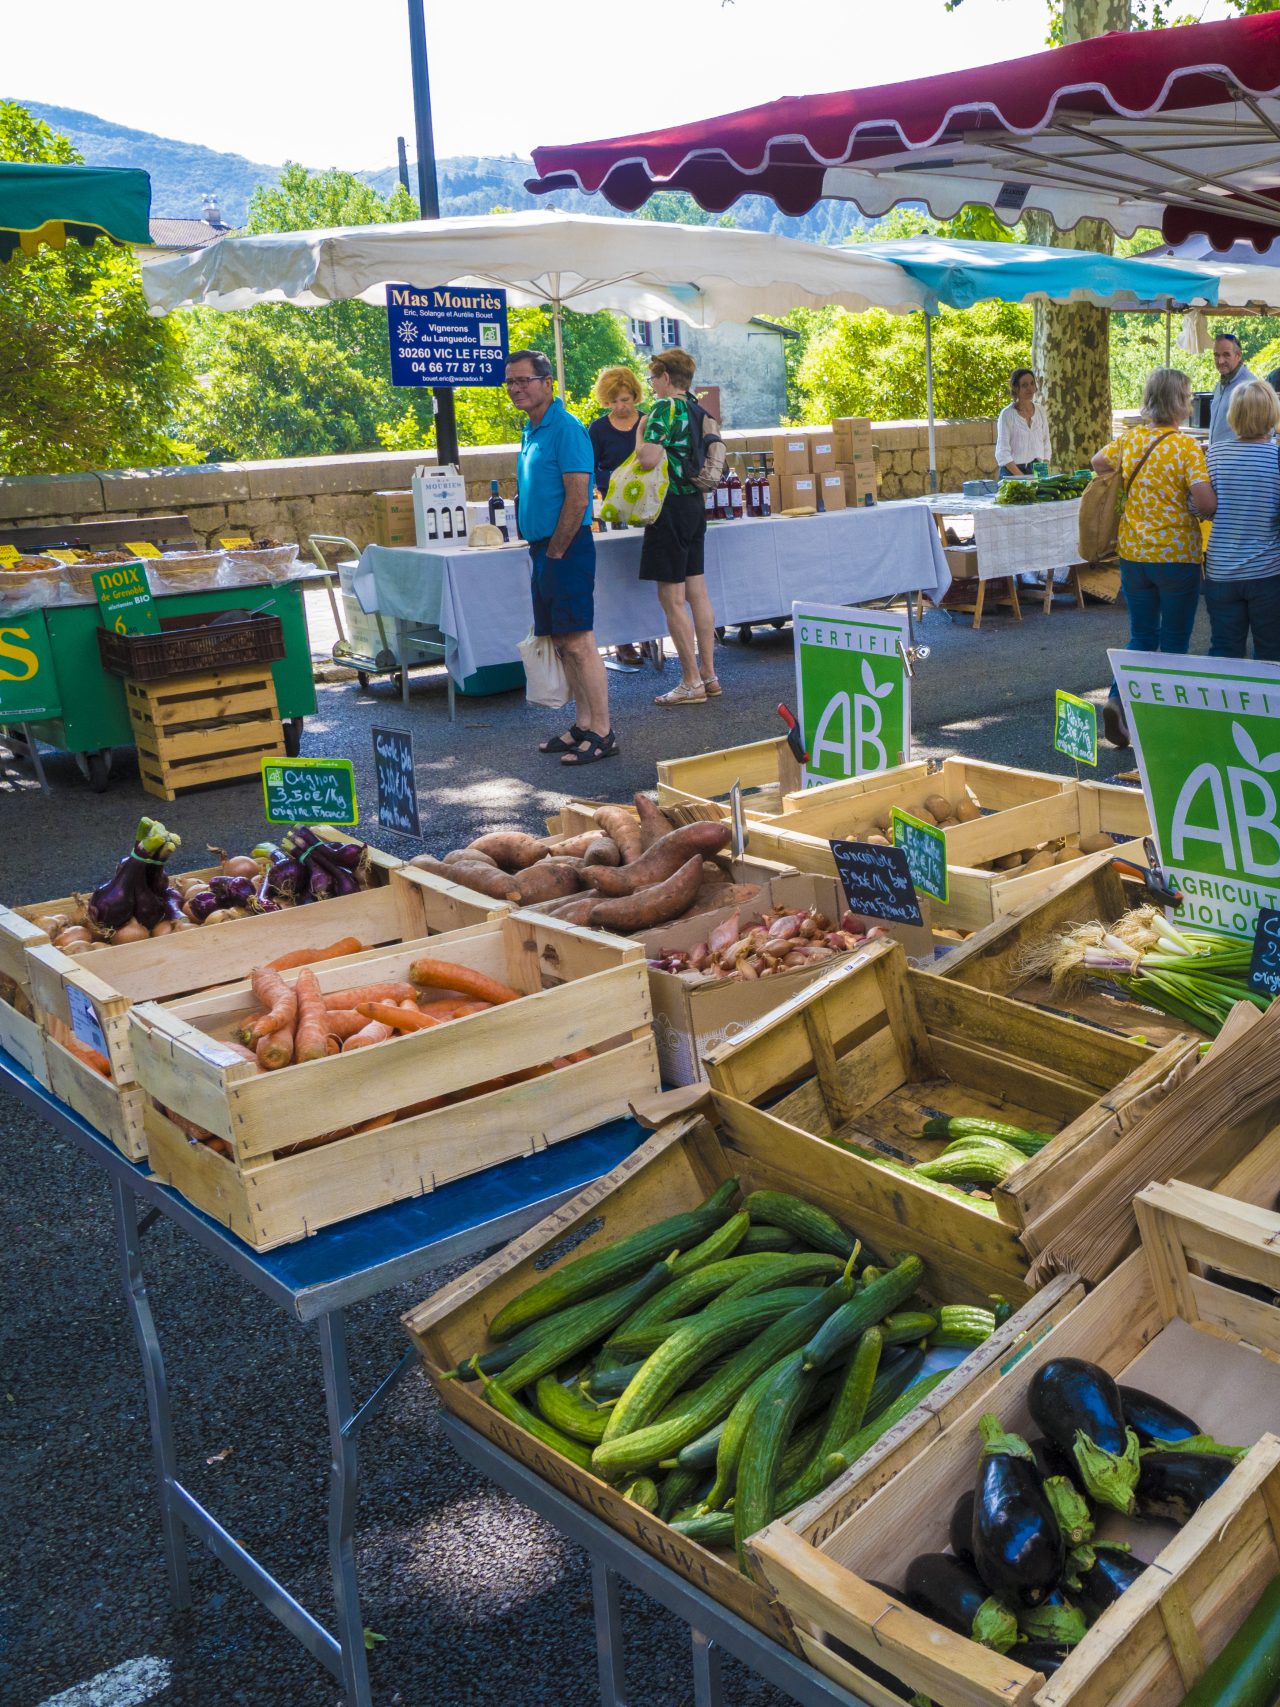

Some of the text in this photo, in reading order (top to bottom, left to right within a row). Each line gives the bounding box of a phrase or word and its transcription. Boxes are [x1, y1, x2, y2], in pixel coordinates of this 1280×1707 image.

[392, 289, 502, 310] Mas Mouriès
[403, 308, 419, 317] Eric,
[420, 309, 445, 319] Solange
[475, 311, 494, 319] Bouet
[428, 323, 469, 333] Vignerons
[421, 335, 478, 344] du Languedoc
[398, 348, 504, 360] 30260 VIC LE FESQ
[411, 362, 493, 373] 04 66 77 87 13
[101, 585, 145, 602] de Grenoble
[134, 594, 150, 604] BIO
[801, 626, 901, 655] CERTIFIÉ
[812, 690, 888, 776] AB
[284, 770, 339, 791] Oignon
[272, 805, 348, 821] origine France
[538, 1170, 626, 1241] NATURE
[489, 1420, 709, 1586] ATLANTIC KIWI
